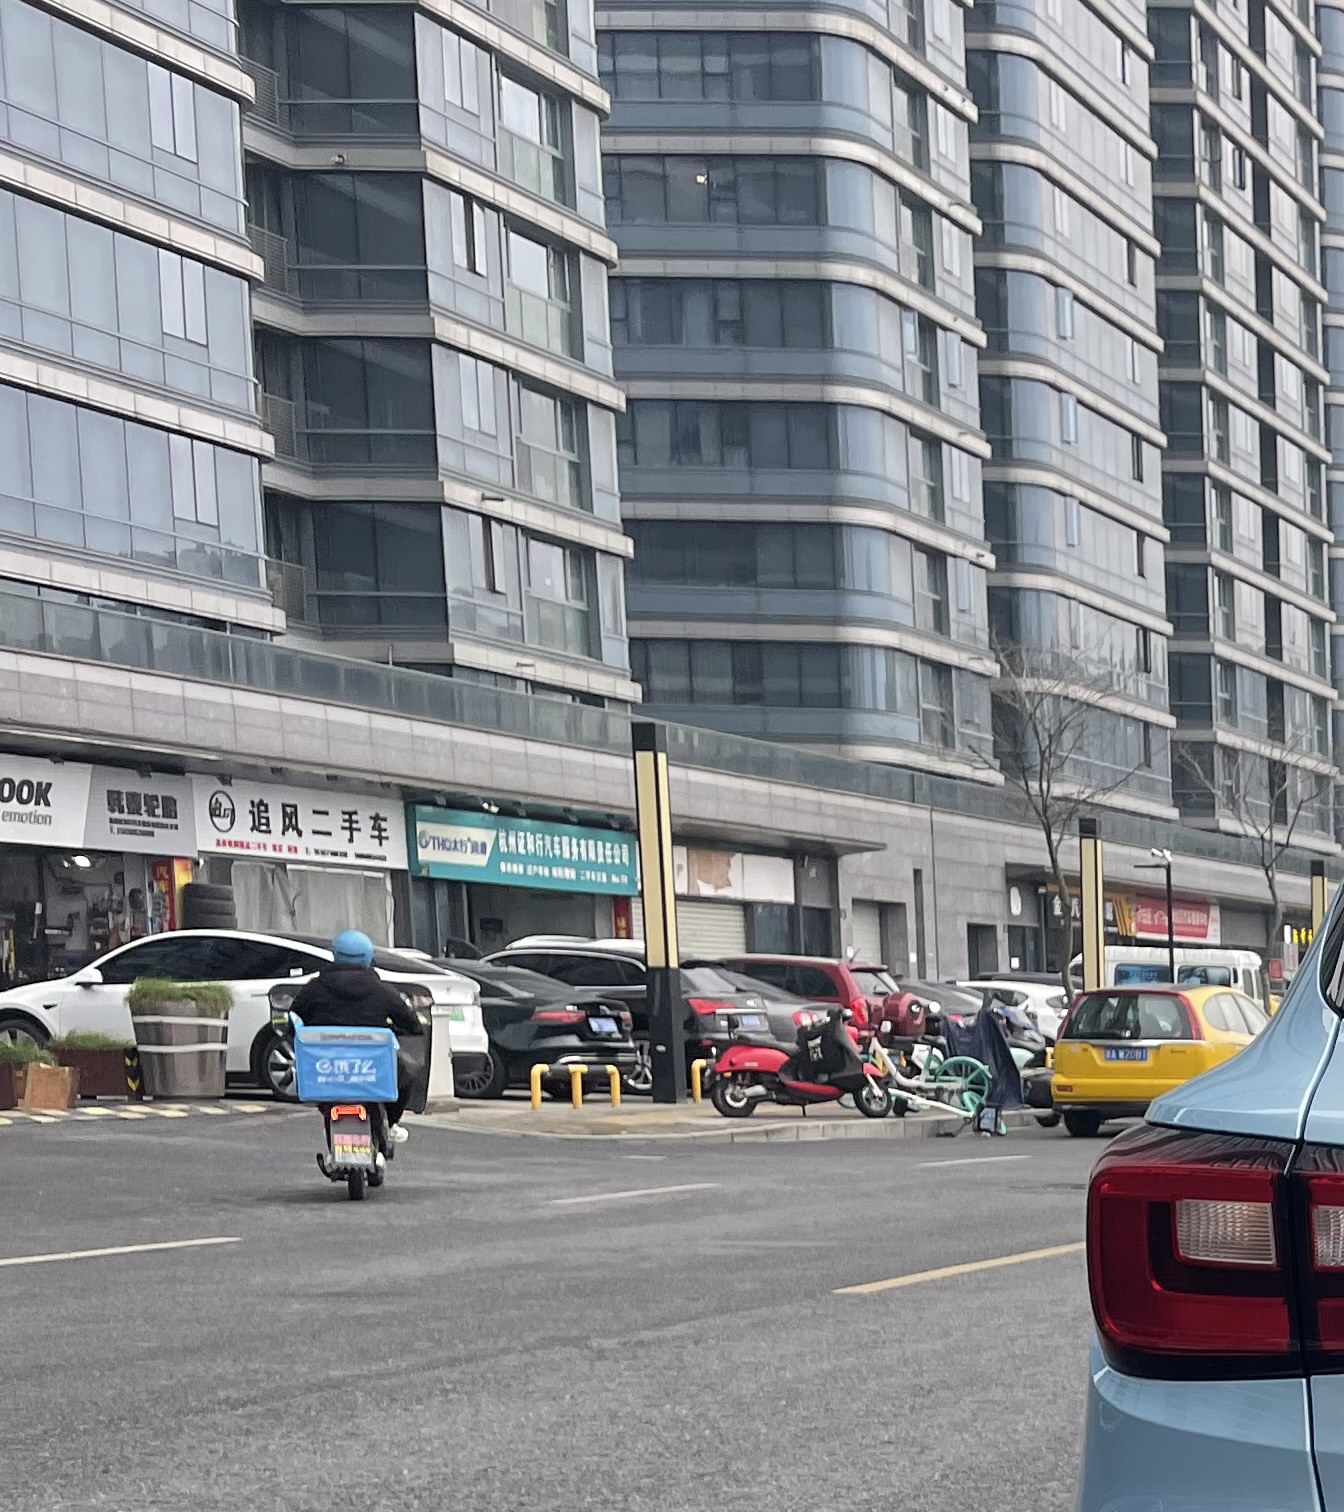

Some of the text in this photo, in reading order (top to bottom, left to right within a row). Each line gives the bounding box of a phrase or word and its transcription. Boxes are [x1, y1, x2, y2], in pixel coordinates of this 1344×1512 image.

[2, 809, 52, 825] emotion
[248, 798, 389, 847] 追风二手车
